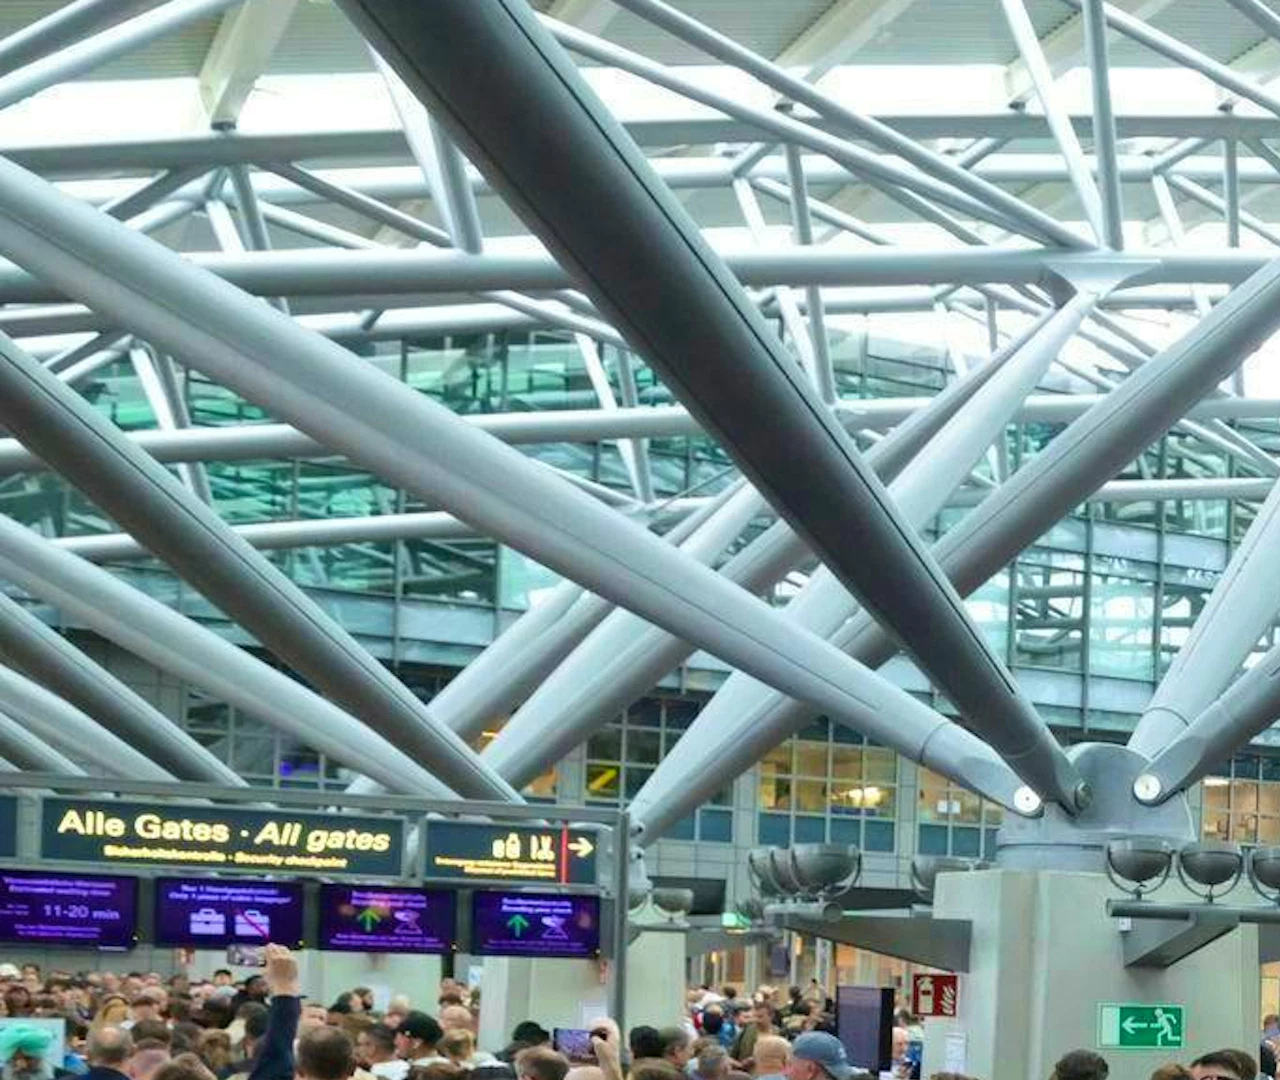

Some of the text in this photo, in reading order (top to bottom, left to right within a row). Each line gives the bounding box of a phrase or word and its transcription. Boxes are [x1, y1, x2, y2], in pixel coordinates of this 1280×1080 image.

[57, 809, 391, 853] Alle Gates All gates
[43, 904, 90, 919] 11-20
[92, 909, 121, 920] min
